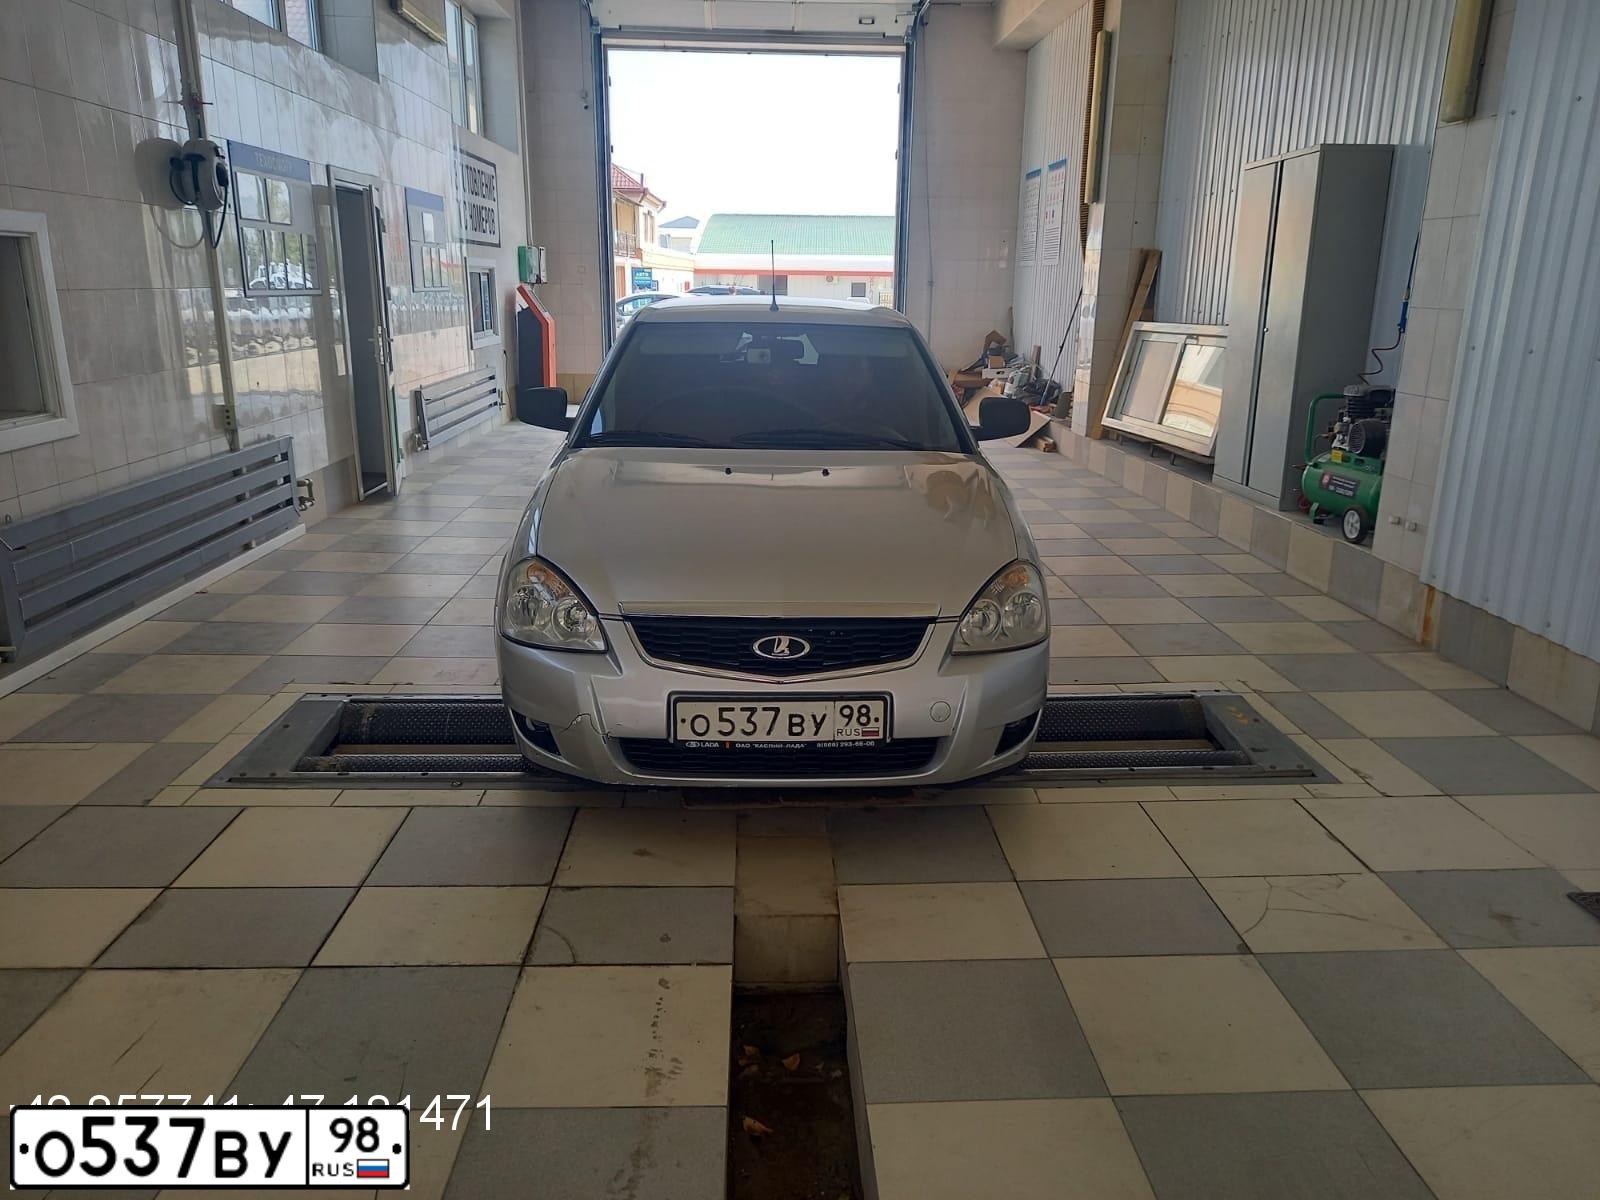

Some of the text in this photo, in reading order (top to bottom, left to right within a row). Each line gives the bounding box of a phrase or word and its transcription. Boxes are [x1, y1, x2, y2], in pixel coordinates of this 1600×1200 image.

[690, 704, 872, 737] О537ВУ 98
[836, 728, 861, 737] RUS
